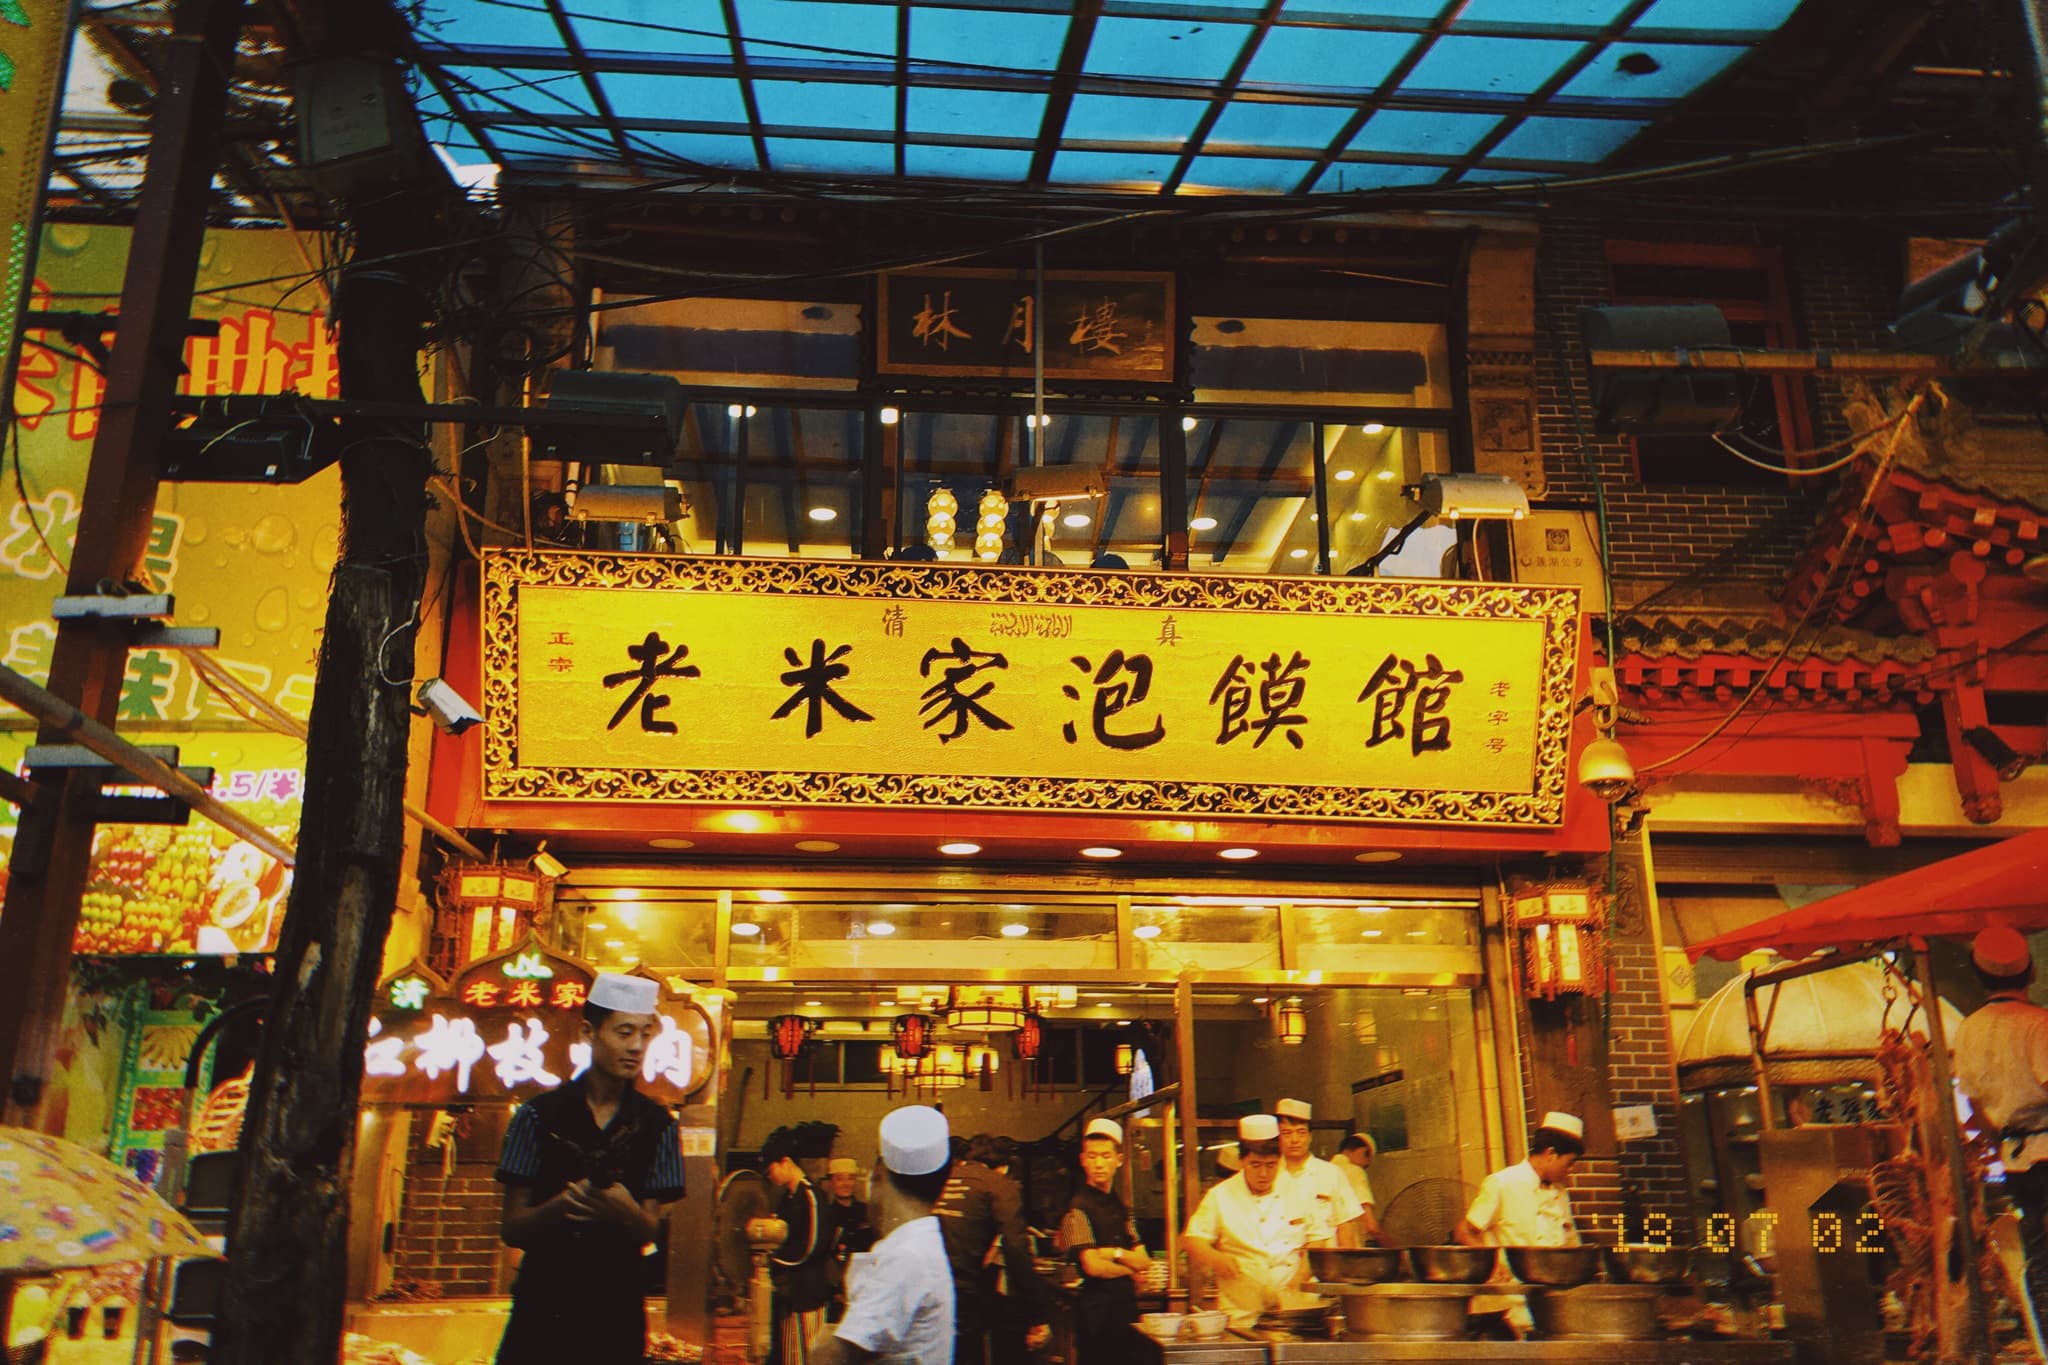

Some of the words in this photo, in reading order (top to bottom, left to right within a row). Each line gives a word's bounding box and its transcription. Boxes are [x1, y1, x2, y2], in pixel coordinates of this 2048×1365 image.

[547, 631, 574, 673] 正宗
[1485, 681, 1511, 754] 老字号
[464, 980, 586, 1007] 老米家
